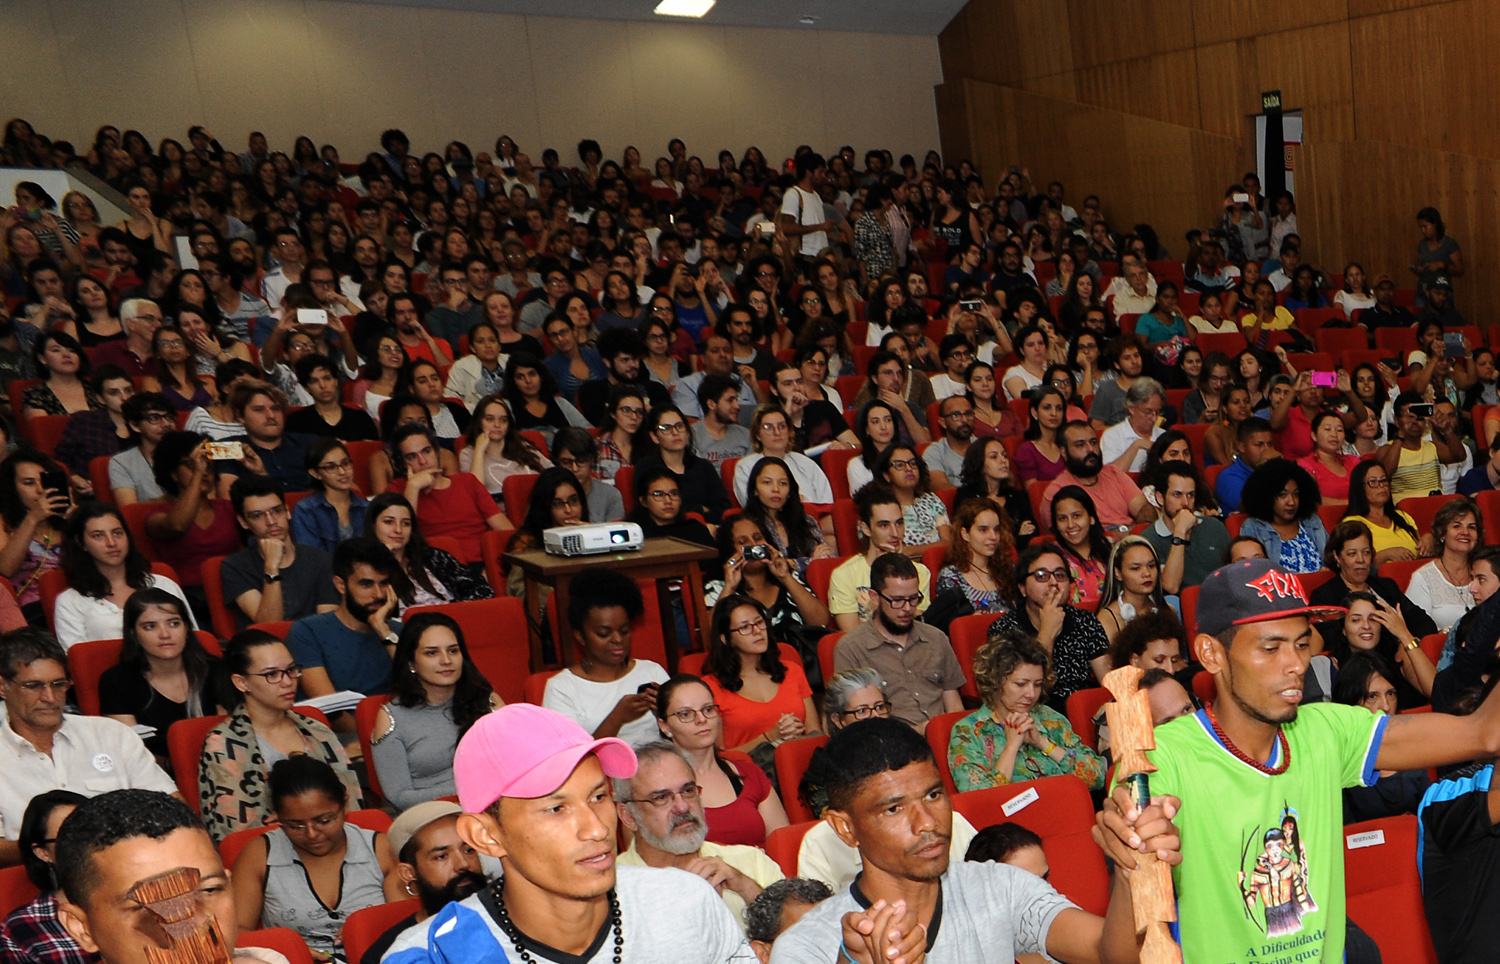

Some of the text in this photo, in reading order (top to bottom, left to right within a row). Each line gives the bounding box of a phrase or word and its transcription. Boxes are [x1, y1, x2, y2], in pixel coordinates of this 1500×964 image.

[1352, 833, 1379, 843] RESERVADO
[1245, 947, 1257, 957] A
[1295, 948, 1320, 963] que
